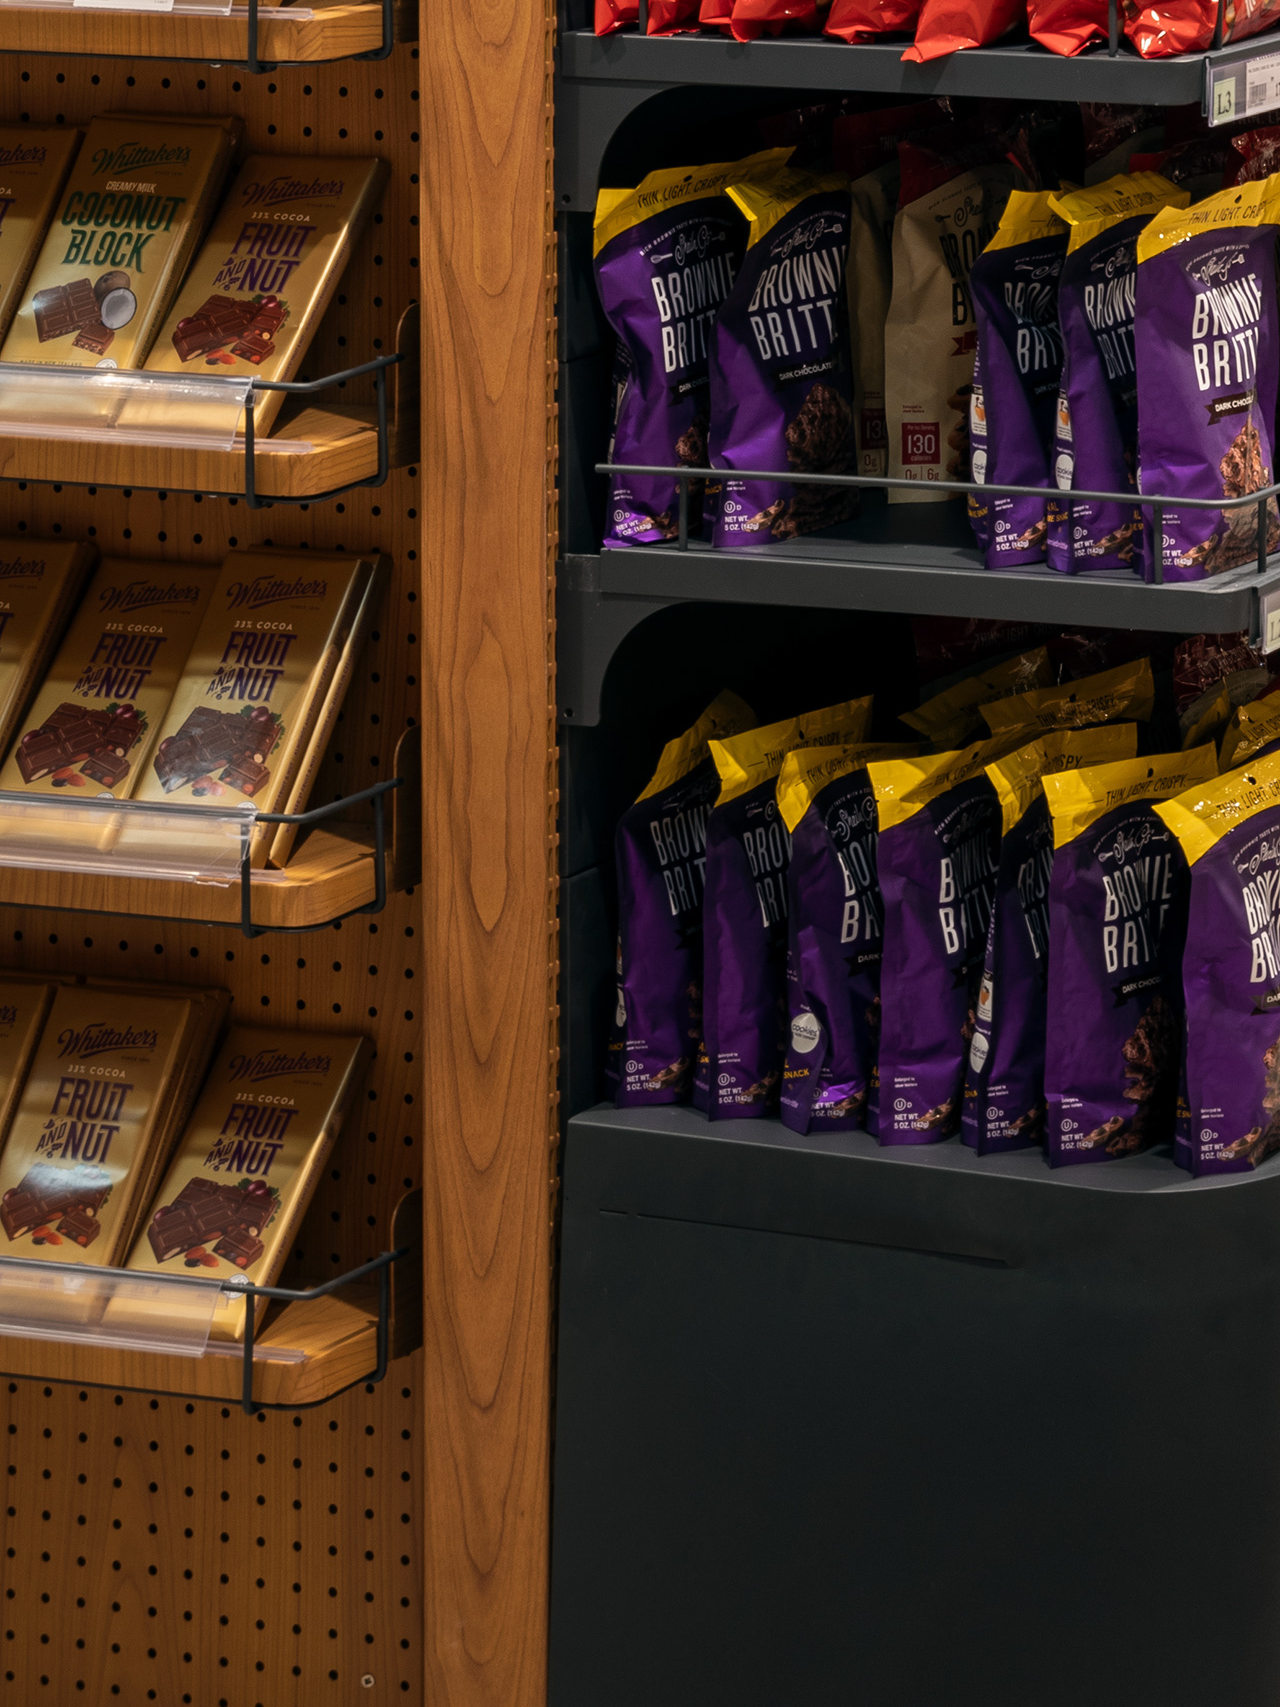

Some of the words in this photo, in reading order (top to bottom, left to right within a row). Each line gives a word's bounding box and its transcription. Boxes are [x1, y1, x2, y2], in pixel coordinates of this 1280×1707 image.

[1218, 91, 1231, 115] L3
[106, 181, 136, 191] CREAMY
[136, 182, 157, 194] MILK
[61, 191, 186, 232] COCONUT
[251, 211, 270, 219] 33%
[273, 213, 310, 222] COCOA
[61, 229, 155, 273] BLOCK
[231, 223, 316, 257] FRUIT
[238, 259, 301, 293] NUT
[234, 620, 253, 628] 33%
[256, 621, 293, 631] COCOA
[221, 631, 297, 666] FRUIT
[229, 667, 285, 702] NUT
